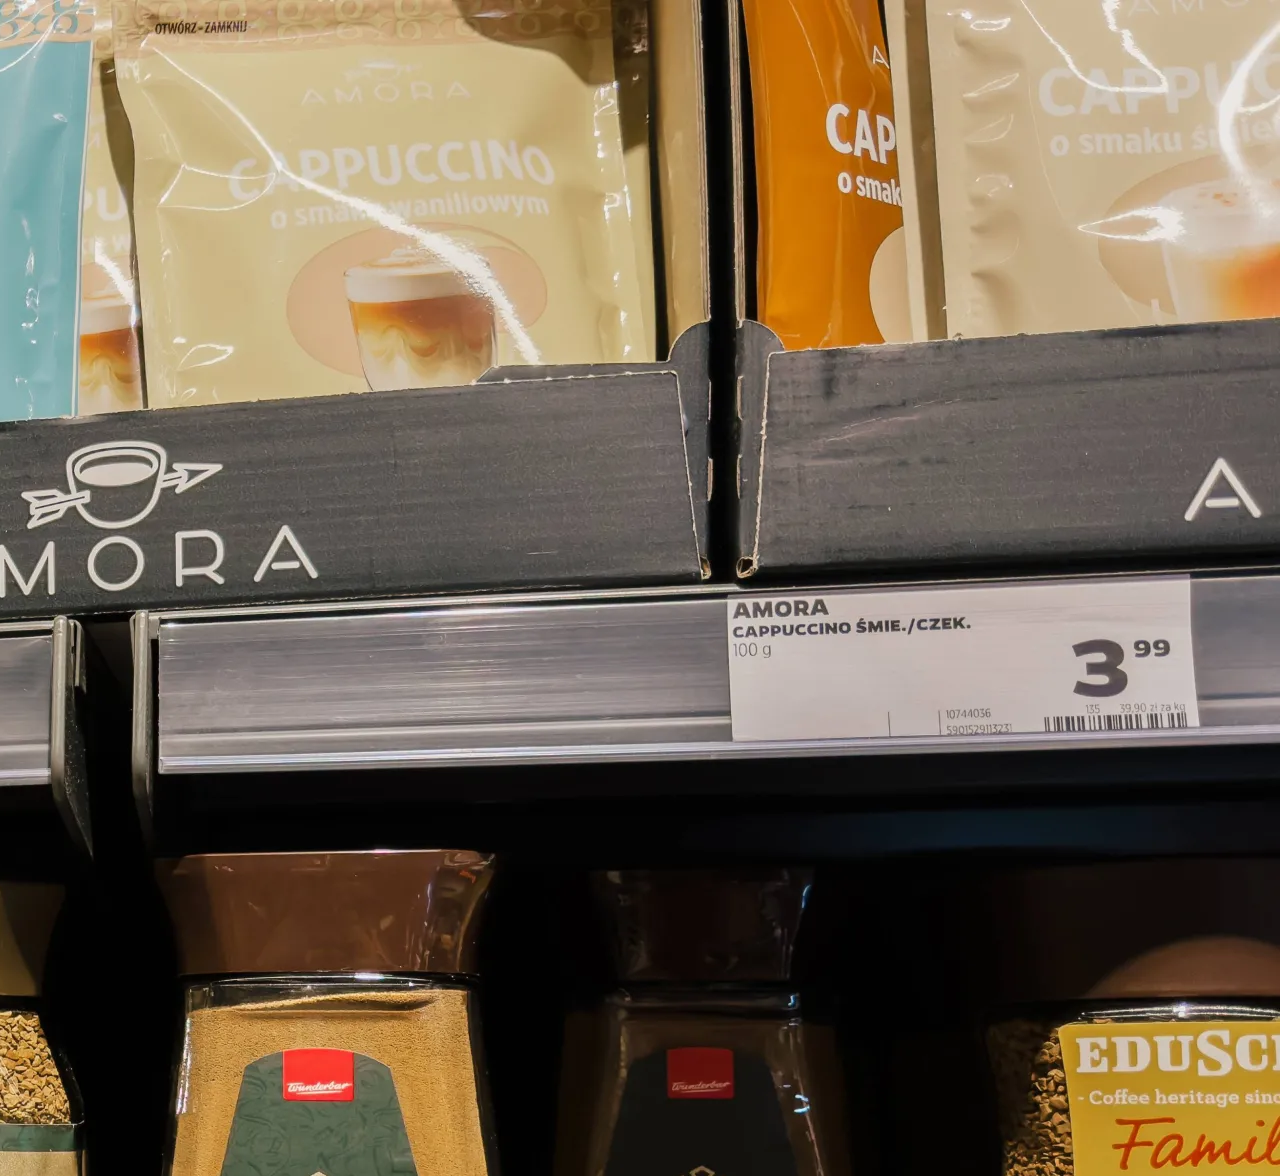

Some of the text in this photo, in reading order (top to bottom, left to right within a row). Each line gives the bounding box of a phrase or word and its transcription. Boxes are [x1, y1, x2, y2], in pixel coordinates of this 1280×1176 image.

[301, 81, 472, 106] AMORA
[1050, 125, 1183, 157] o smaku
[228, 140, 555, 202] CAPPUCCINO
[837, 171, 852, 194] o
[733, 598, 829, 619] AMORA
[733, 615, 972, 639] CAPPUCCINO ŚMIE./CZEK.
[733, 641, 758, 658] 100
[1072, 639, 1171, 698] 3 99
[1088, 1088, 1240, 1108] Coffee heritage
